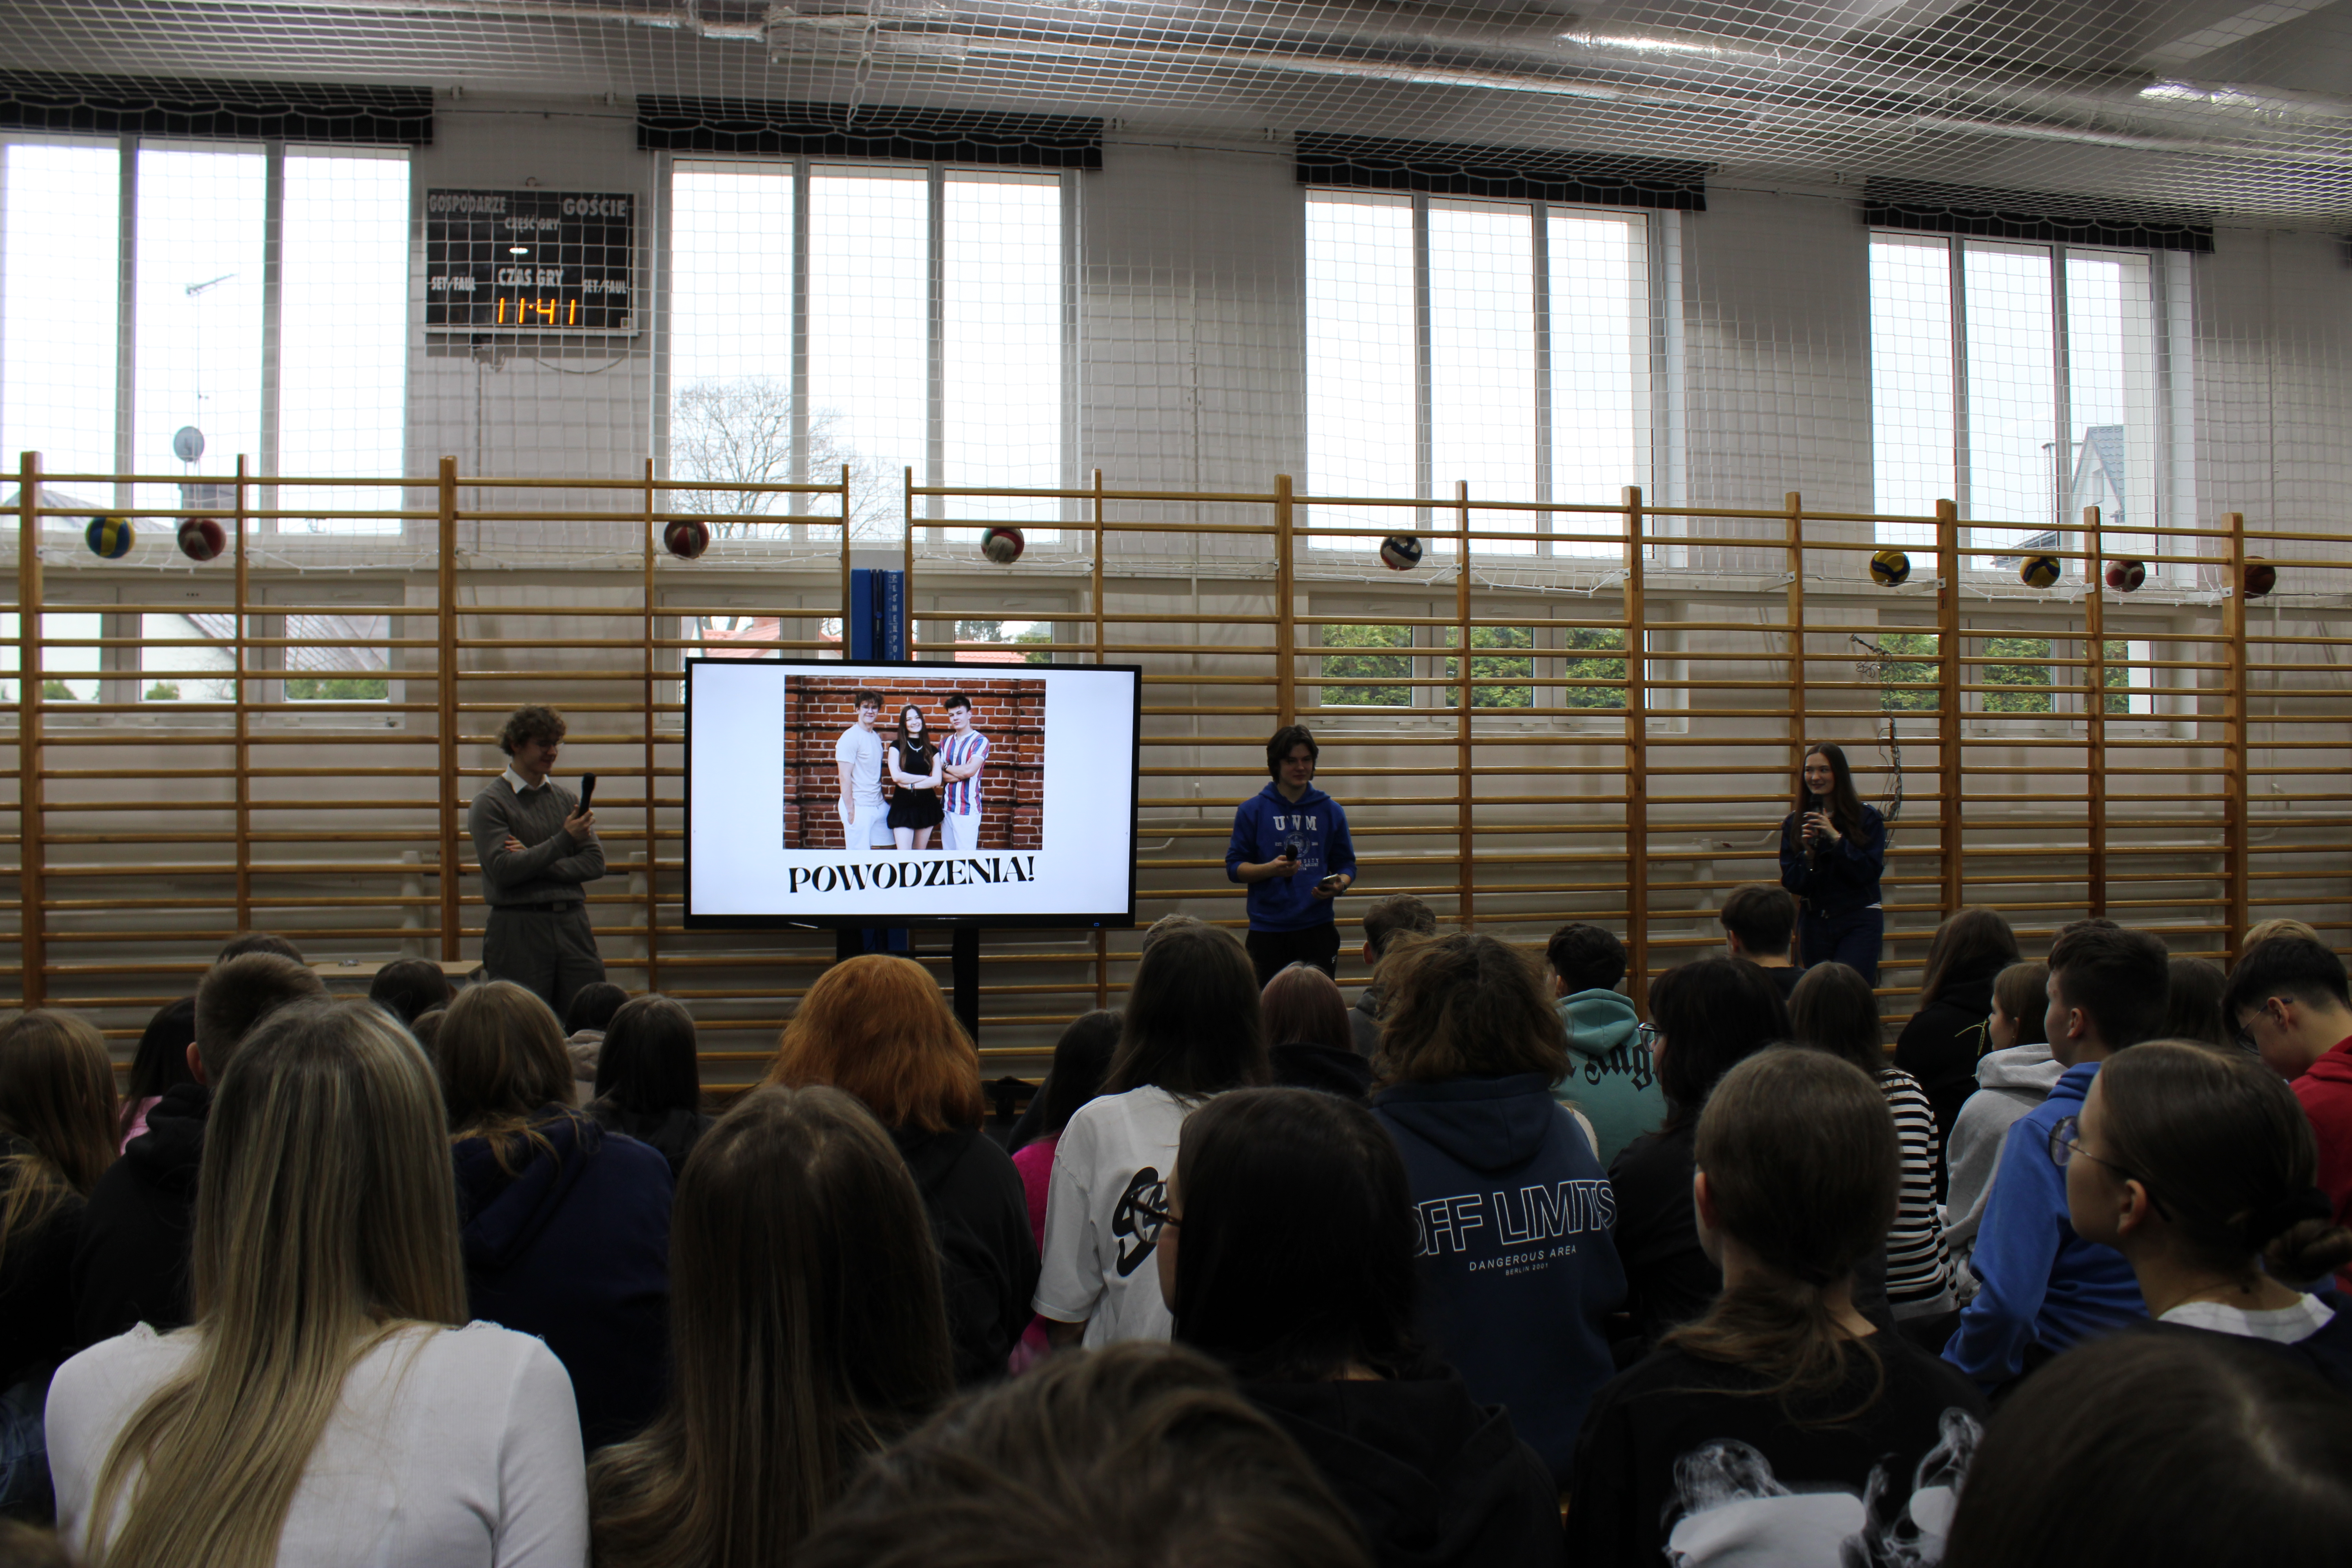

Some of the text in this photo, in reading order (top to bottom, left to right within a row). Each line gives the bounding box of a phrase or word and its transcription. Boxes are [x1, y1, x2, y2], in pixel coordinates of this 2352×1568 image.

[429, 194, 506, 213] GOSPODARZE
[563, 194, 626, 216] GOŚCIE
[538, 218, 560, 230] GRY
[498, 268, 563, 287] CZAS GRY
[1273, 815, 1317, 831] UWM
[789, 856, 1034, 893] POWODZENIA!
[1493, 1179, 1617, 1245] LIMITS
[1470, 1245, 1576, 1271] DANGEROUS AREA
[1506, 1266, 1529, 1276] BERLIN
